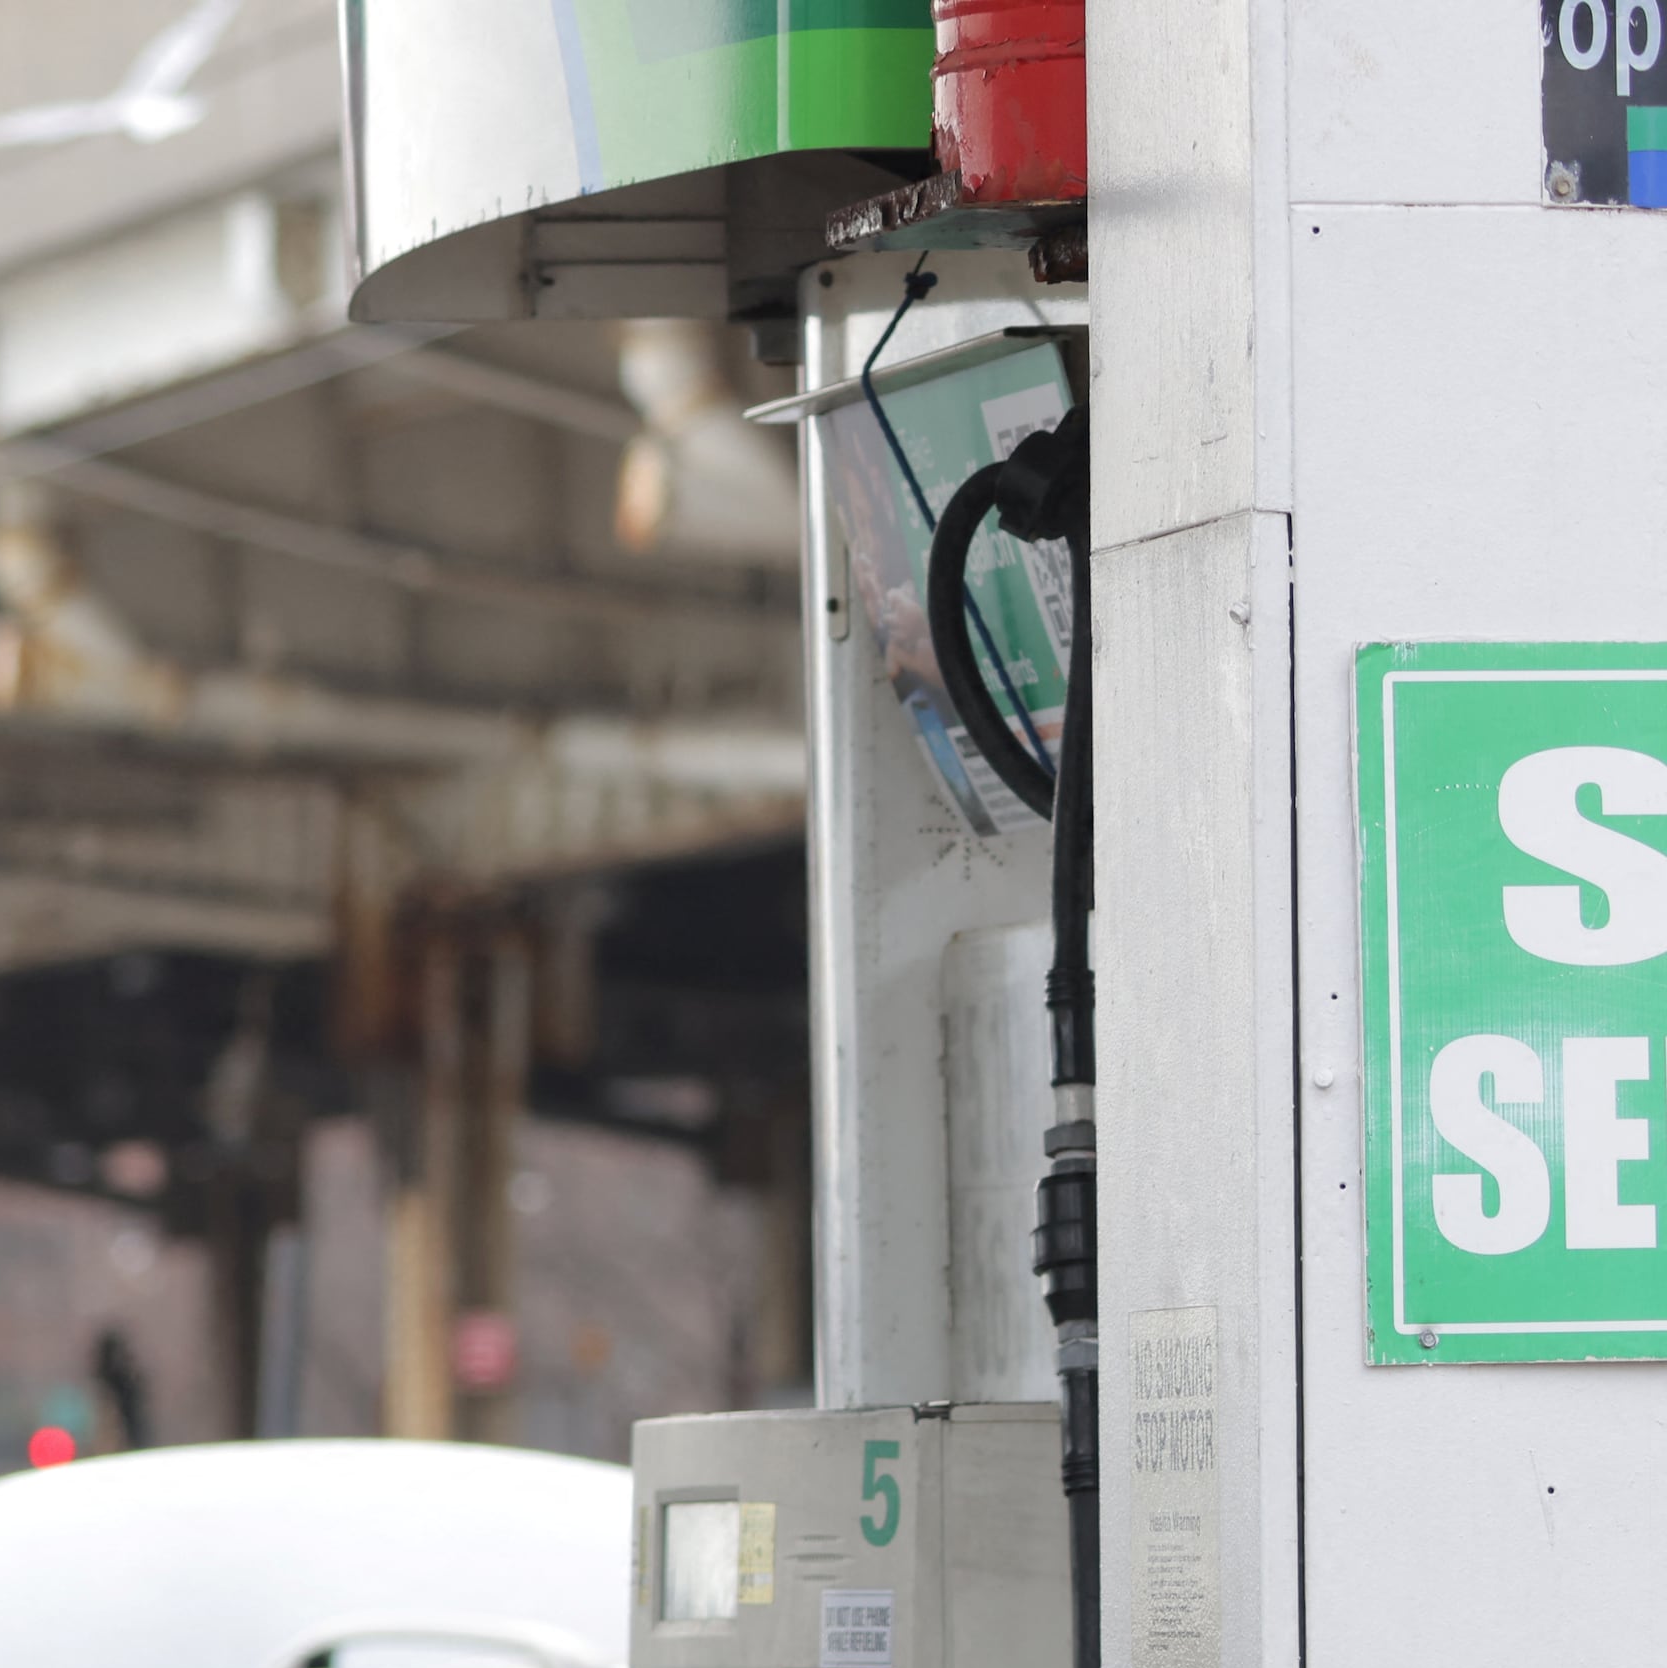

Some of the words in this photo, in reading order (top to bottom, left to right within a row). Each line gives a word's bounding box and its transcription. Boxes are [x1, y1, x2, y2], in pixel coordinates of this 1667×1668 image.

[1559, 0, 1661, 96] op
[1429, 1033, 1667, 1255] SE
[1155, 1336, 1213, 1398] SMOKING
[1135, 1411, 1166, 1473] STOP
[1170, 1408, 1214, 1473] MOTOR
[860, 1440, 901, 1547] 5
